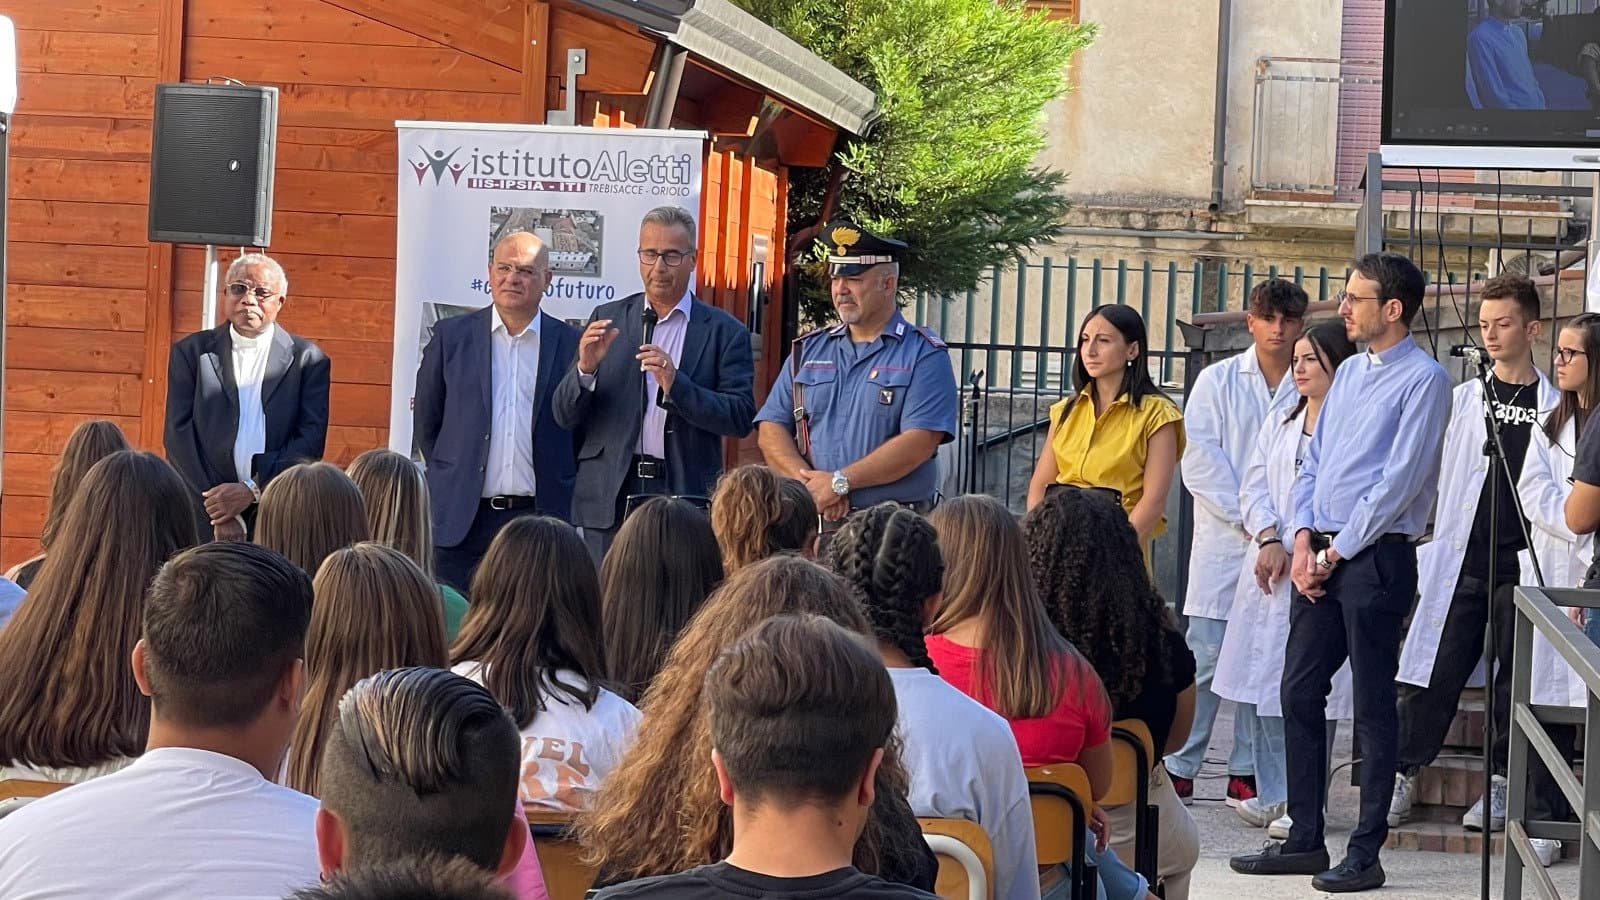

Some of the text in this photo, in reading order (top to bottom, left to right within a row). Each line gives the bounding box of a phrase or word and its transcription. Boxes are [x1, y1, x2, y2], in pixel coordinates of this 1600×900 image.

[472, 178, 544, 191] IIS-IPSIA
[559, 181, 581, 192] ITI
[589, 183, 644, 195] TREBISACCE
[651, 185, 690, 197] ORIOLO
